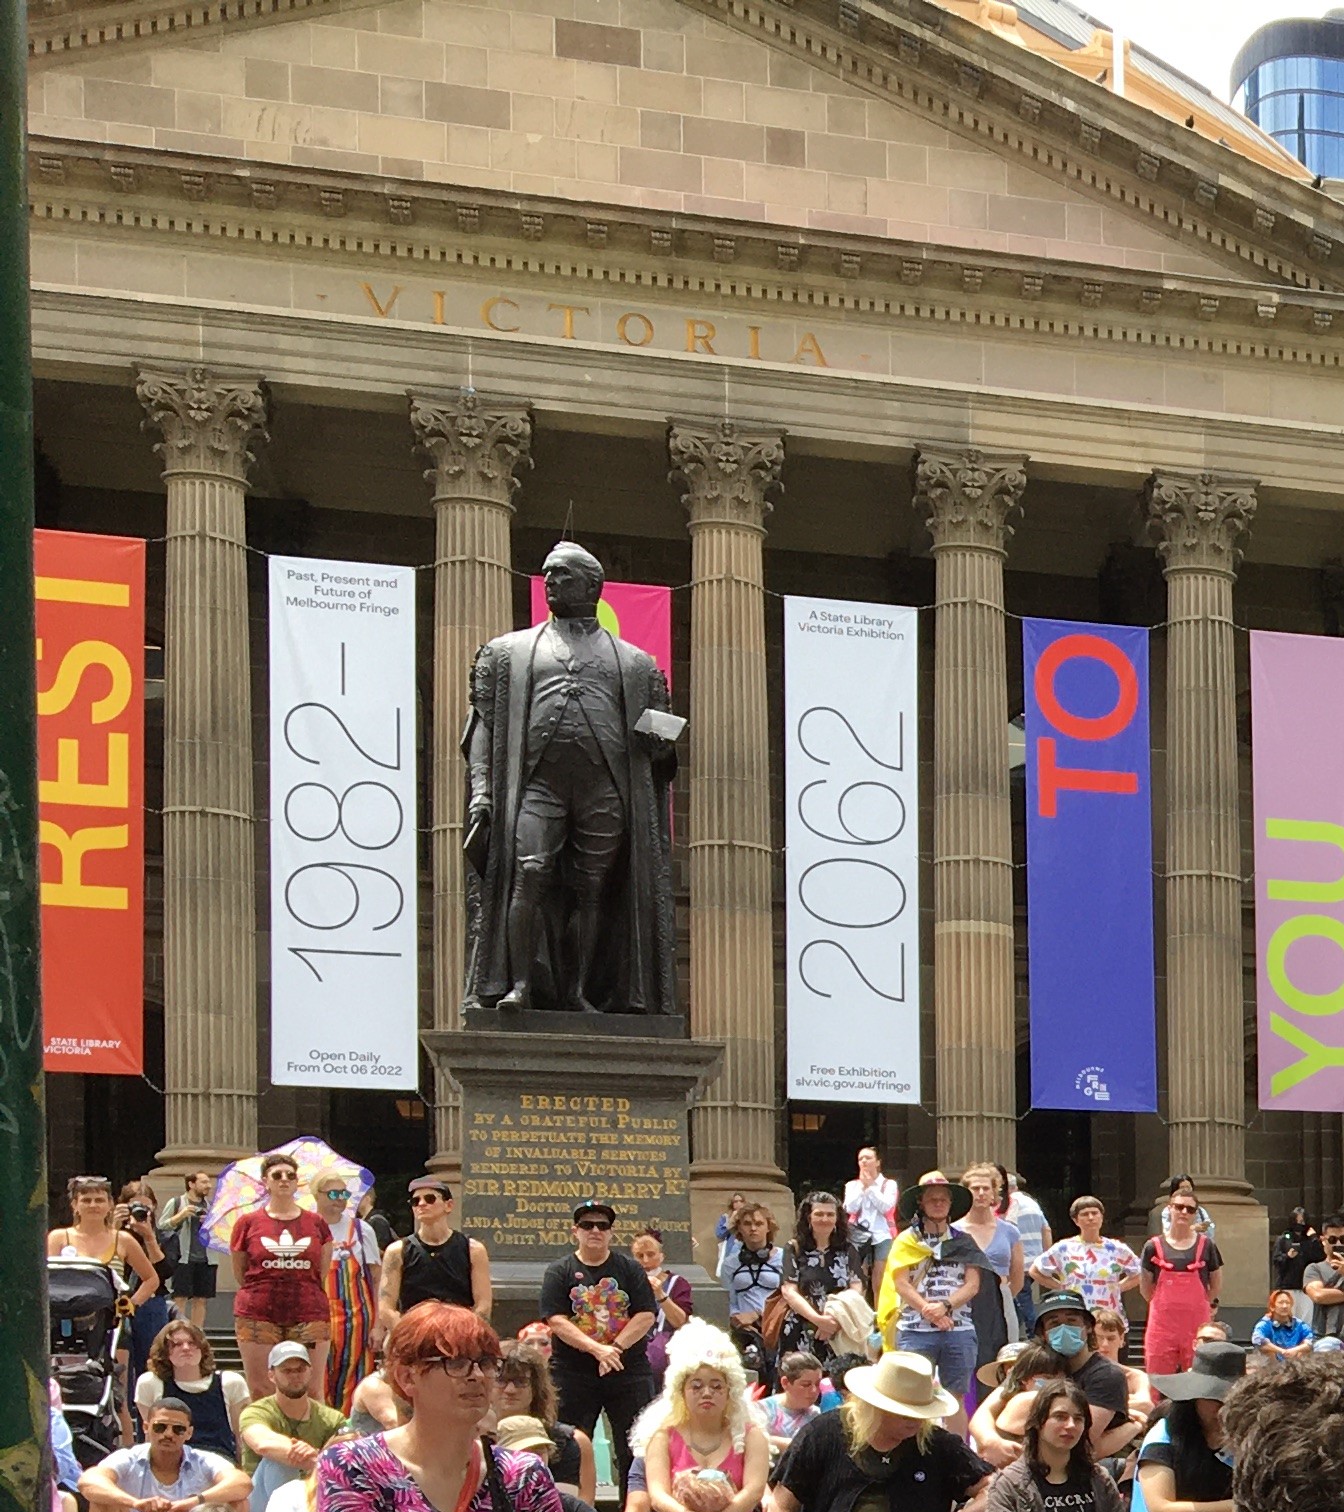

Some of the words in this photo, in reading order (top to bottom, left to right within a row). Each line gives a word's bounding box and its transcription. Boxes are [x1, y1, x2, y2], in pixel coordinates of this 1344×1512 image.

[359, 281, 829, 368] VICTORIA
[287, 569, 318, 583] Past,
[321, 572, 371, 586] Present
[373, 578, 398, 588] and
[314, 585, 356, 598] Future
[359, 590, 372, 599] of
[286, 596, 357, 612] Melbourne
[360, 602, 399, 617] Fringe
[809, 610, 818, 620] A
[820, 611, 851, 624] State
[854, 614, 893, 630] Library
[798, 622, 844, 636] Victoria
[846, 627, 904, 641] Exhibition
[1034, 633, 1139, 819] TO
[798, 706, 907, 1003] 2062
[43, 1046, 92, 1056] VICTORIA
[50, 1037, 77, 1047] STATE
[80, 1038, 121, 1049] LIBRARY
[309, 1049, 345, 1062] Open
[349, 1051, 381, 1064] Daily
[287, 1062, 320, 1073] From
[323, 1063, 348, 1074] Oct
[351, 1065, 368, 1075] 06
[371, 1065, 402, 1076] 2022
[810, 1065, 836, 1075] Free
[838, 1066, 897, 1078] Exhibition
[795, 1077, 912, 1094] slv.vic.gov.au/fringe
[520, 1095, 631, 1112] ERECTED
[474, 1113, 496, 1125] BY
[501, 1114, 513, 1125] A
[520, 1115, 611, 1128] GRATEFUL
[469, 1130, 488, 1141] TO
[492, 1131, 586, 1143] PERPETUATE
[589, 1133, 618, 1144] THE
[623, 1134, 681, 1146] MEMORY
[485, 1147, 501, 1158] OF
[506, 1147, 596, 1160] INVALUABLE
[601, 1149, 667, 1161] SERVICES
[470, 1163, 549, 1174] RENDERED
[554, 1165, 572, 1175] TO
[574, 1161, 660, 1178] VICTORIA
[663, 1167, 683, 1179] BY
[464, 1180, 502, 1196] SIR
[503, 1181, 594, 1197] REDMOND
[595, 1182, 664, 1199] BARRY
[611, 1203, 638, 1214] AWS
[463, 1217, 490, 1228] AND
[490, 1217, 502, 1228] A
[546, 1218, 564, 1229] OF
[261, 1257, 311, 1270] adidas
